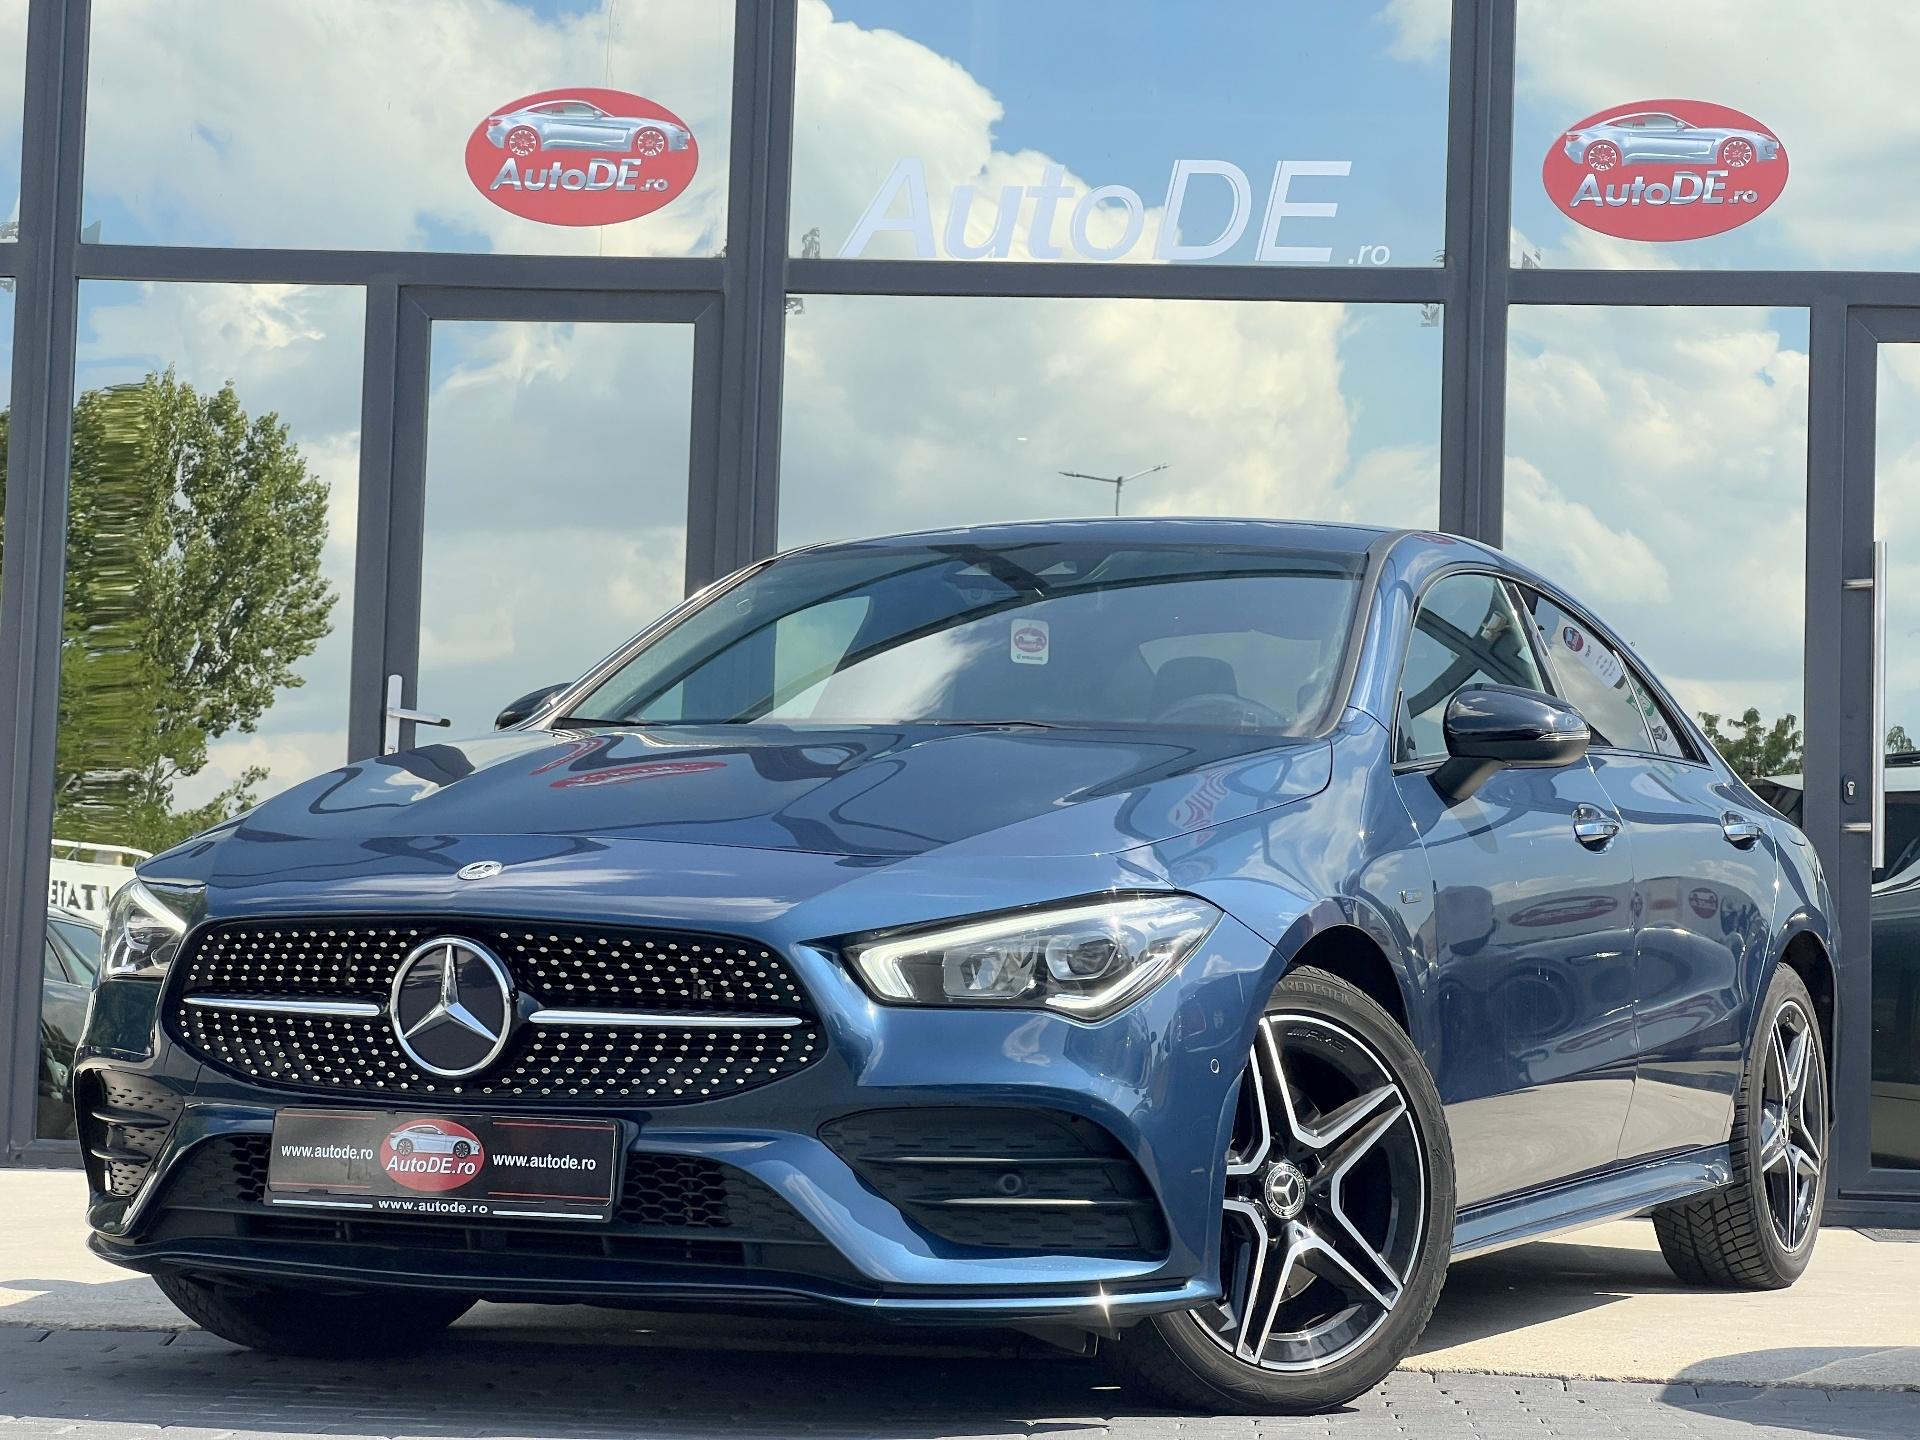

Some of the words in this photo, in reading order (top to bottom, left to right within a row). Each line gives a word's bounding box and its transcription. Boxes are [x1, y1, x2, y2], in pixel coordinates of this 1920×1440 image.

[490, 157, 669, 191] AutoDE.ro
[1569, 170, 1758, 207] AutoDE.ro
[281, 1145, 374, 1160] www.autode.ro
[386, 1155, 476, 1175] AutoDE.ro
[492, 1154, 597, 1171] www.autode.ro
[378, 1200, 488, 1214] www.autode.ro
